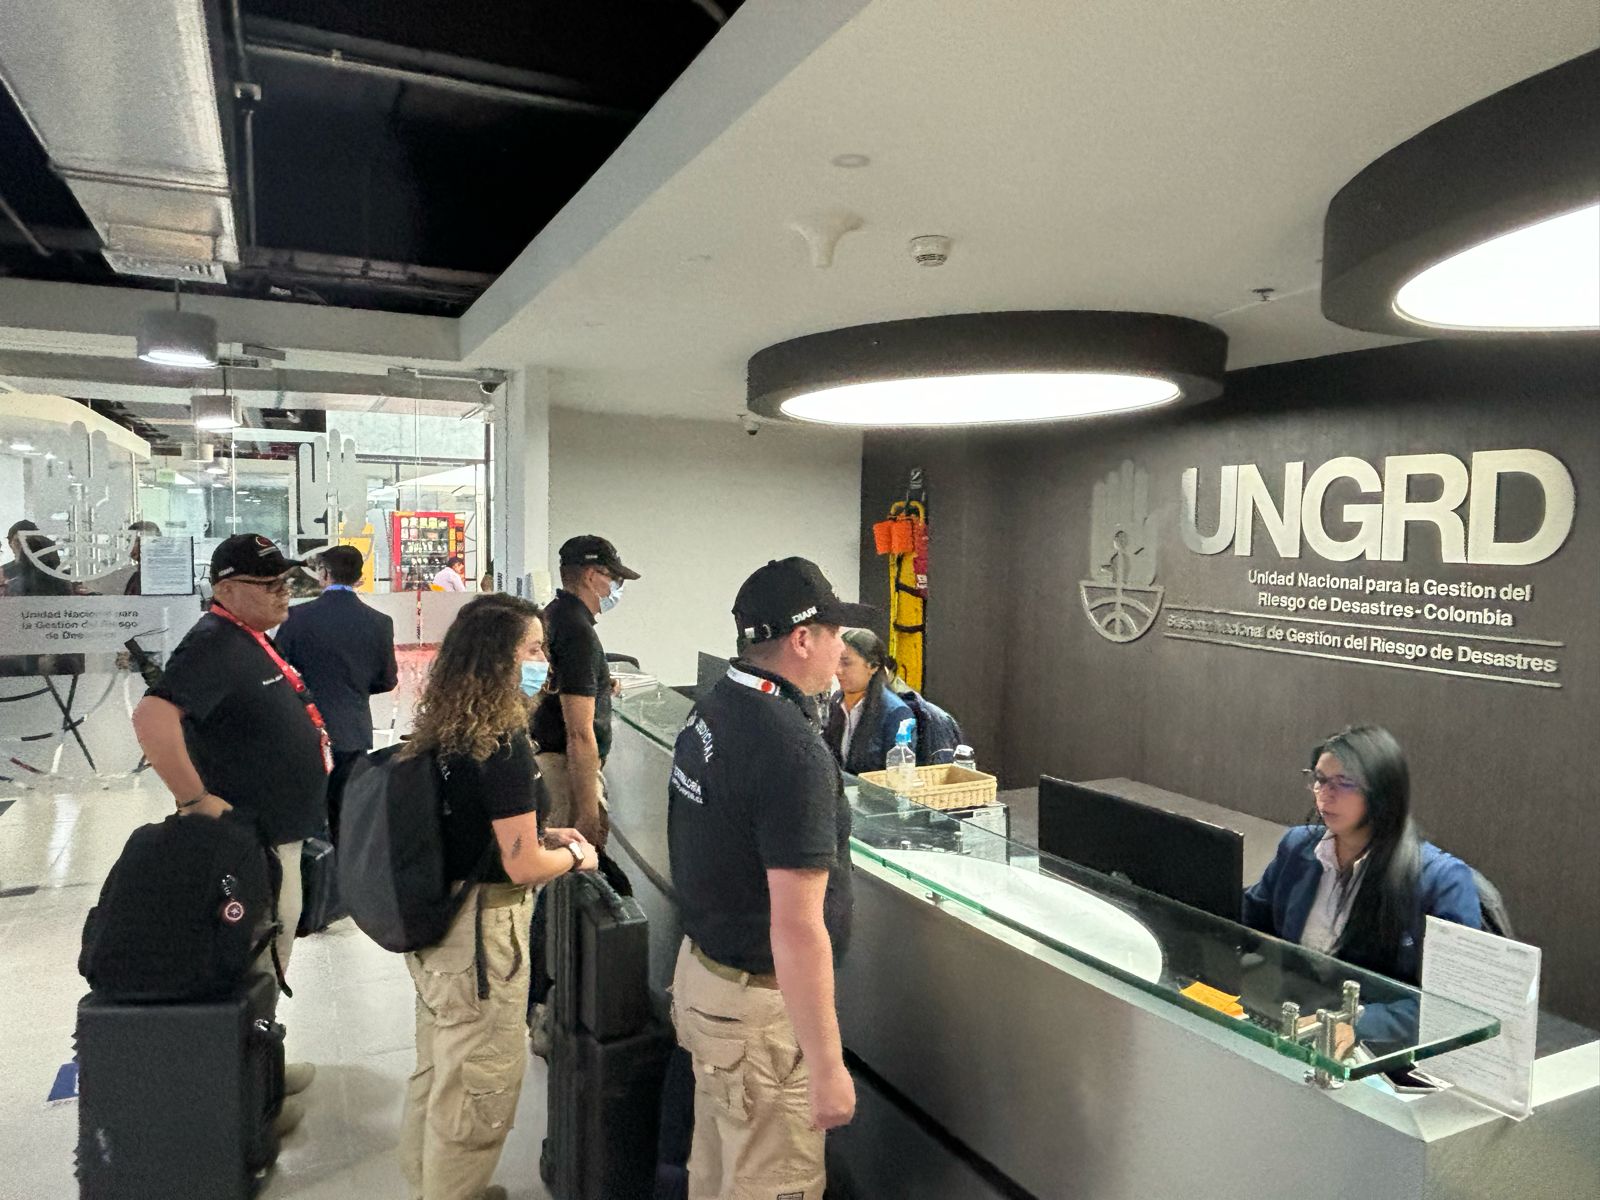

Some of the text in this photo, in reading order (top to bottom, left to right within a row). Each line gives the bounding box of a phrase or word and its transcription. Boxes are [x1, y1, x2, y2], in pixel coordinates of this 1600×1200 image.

[1181, 449, 1576, 566] UNGRD
[1249, 569, 1533, 602] Unidad Nacional para la Gestion del
[1258, 592, 1306, 611] Riesgo
[1309, 595, 1327, 610] de
[21, 609, 61, 620] Unidad
[1267, 624, 1284, 640] de
[1286, 628, 1342, 648] Gestion
[1344, 635, 1367, 651] del
[1370, 636, 1428, 660] Riesgo
[1430, 644, 1453, 660] de
[1457, 646, 1559, 673] Desastres
